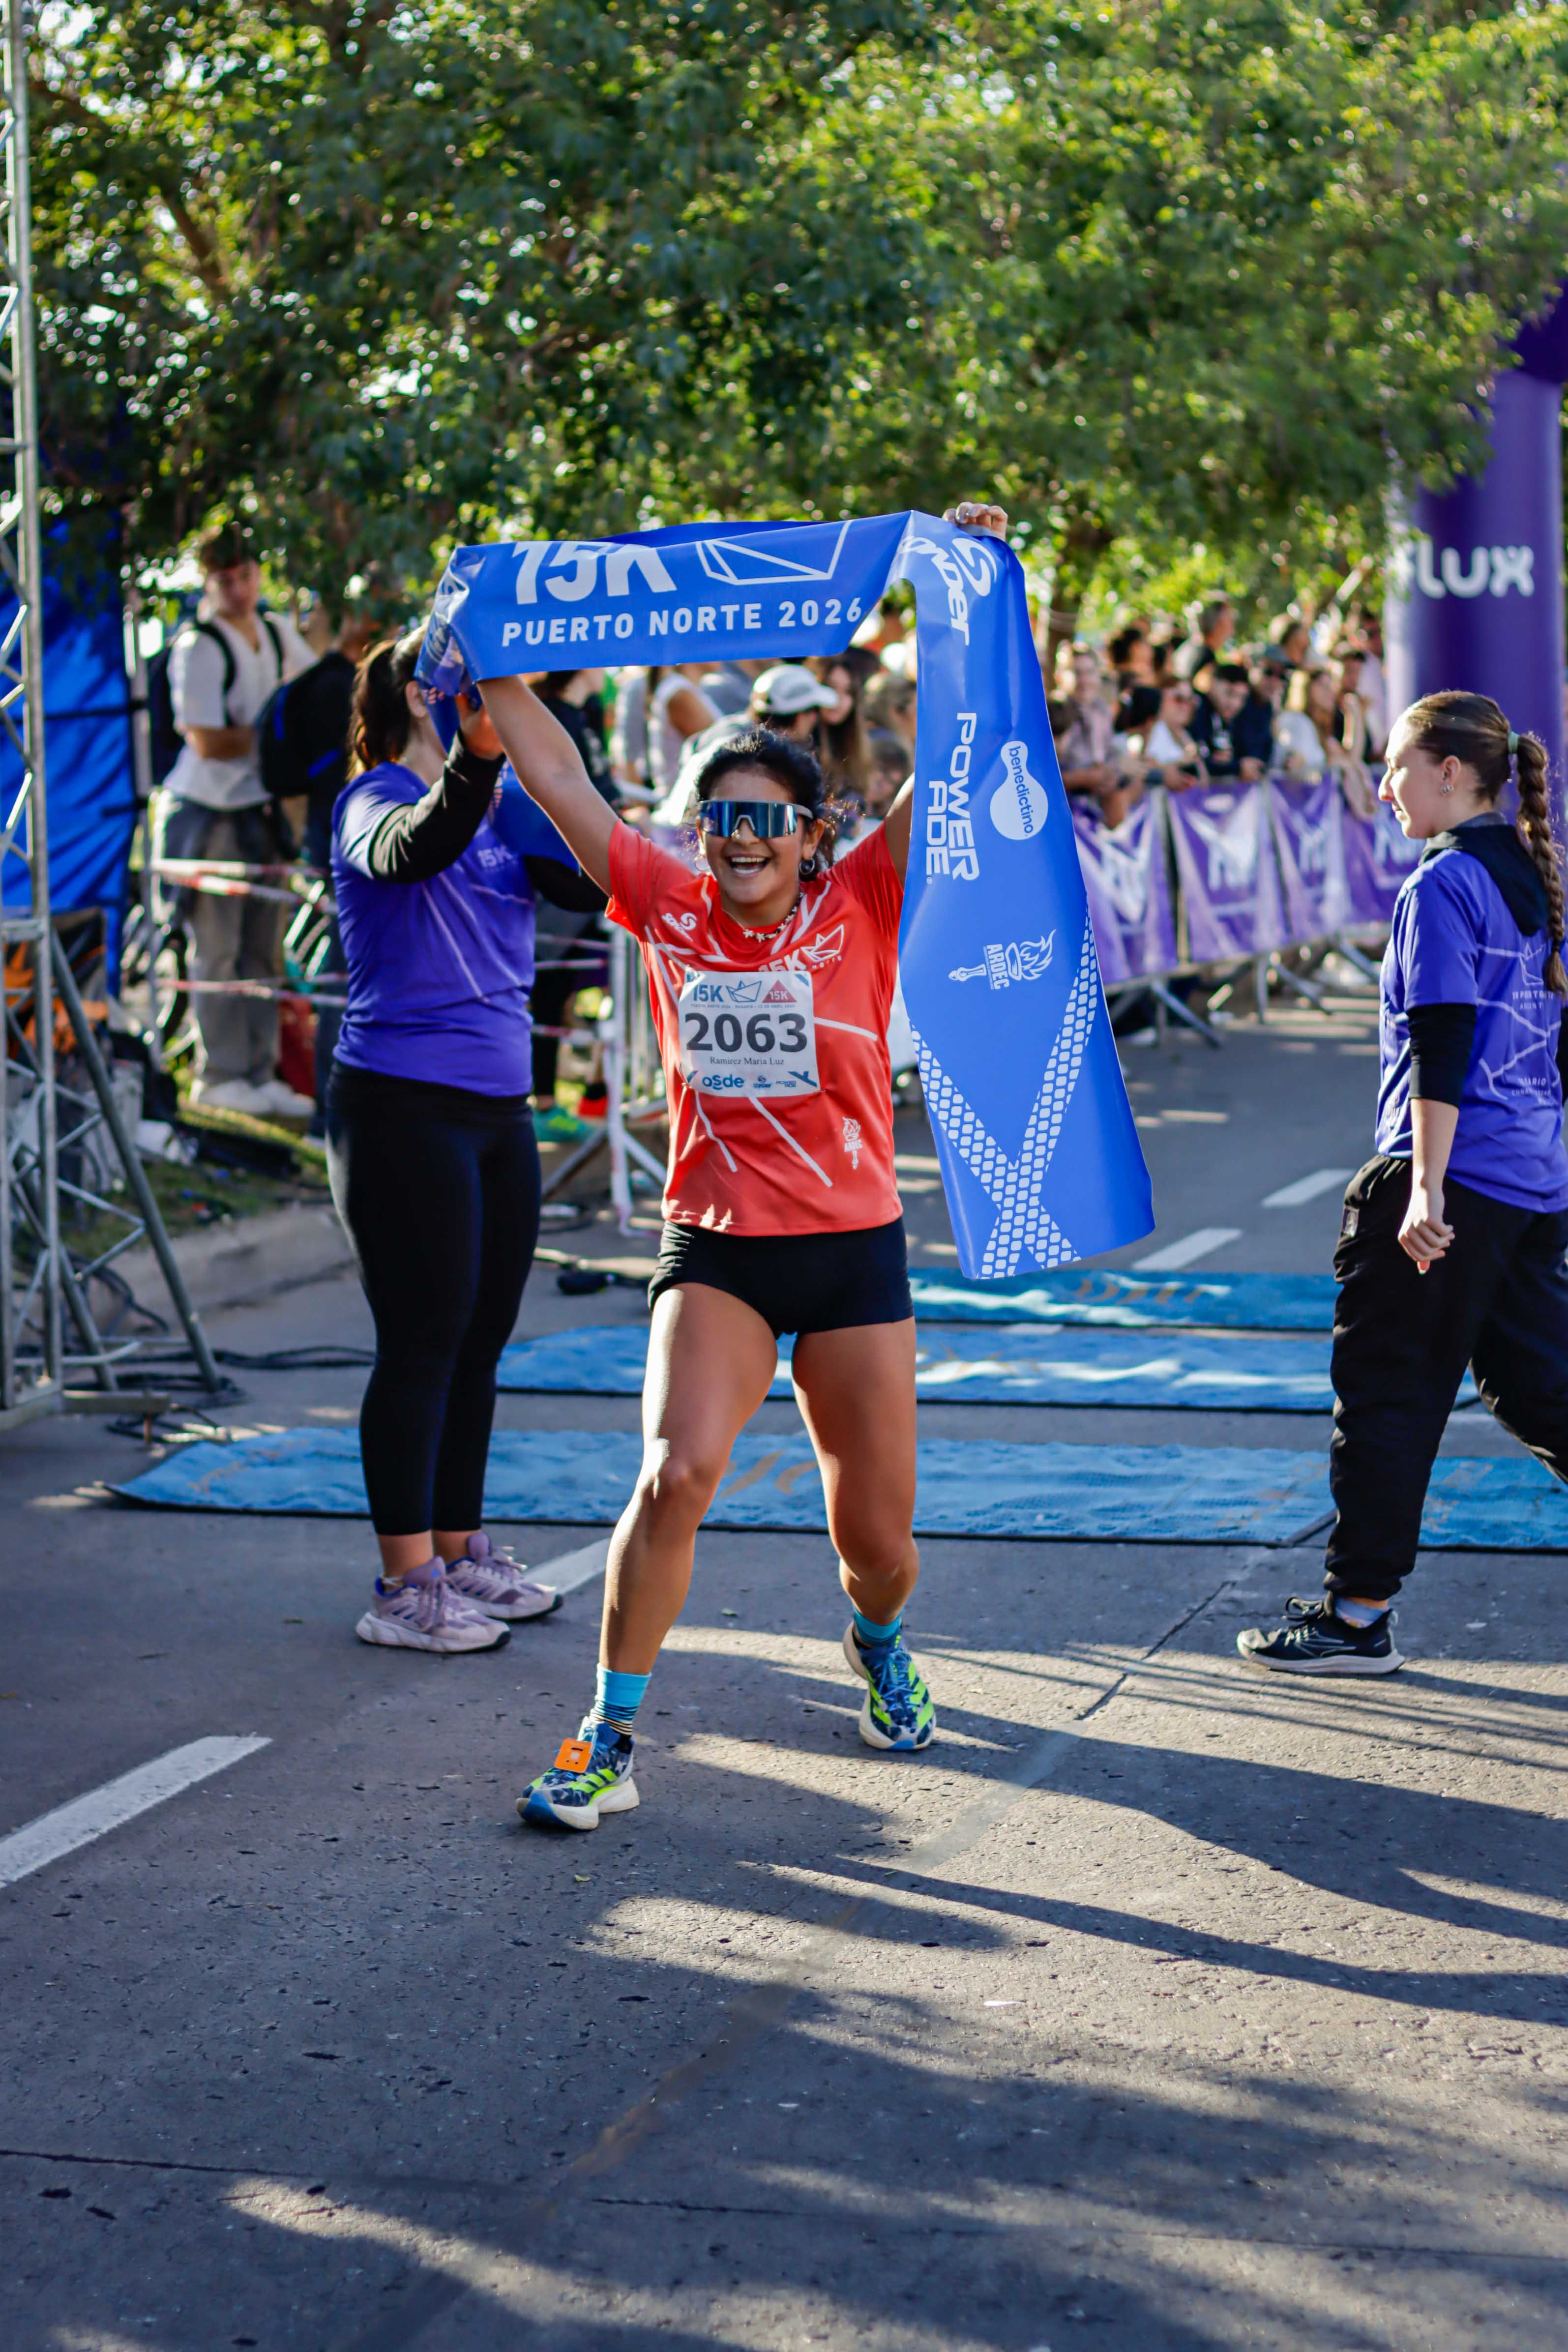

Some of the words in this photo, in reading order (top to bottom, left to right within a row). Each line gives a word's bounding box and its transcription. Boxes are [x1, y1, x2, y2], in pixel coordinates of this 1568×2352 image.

[502, 613, 633, 647] PUERTO
[649, 603, 762, 636] NORTE
[778, 597, 862, 628] 2026
[947, 712, 980, 881] POWER
[1008, 745, 1034, 834] benedictino
[986, 943, 1010, 990] ARDEC
[693, 984, 724, 1002] 15K
[769, 991, 788, 1000] 15K
[685, 1013, 808, 1053] 2063
[702, 1074, 744, 1088] osde
